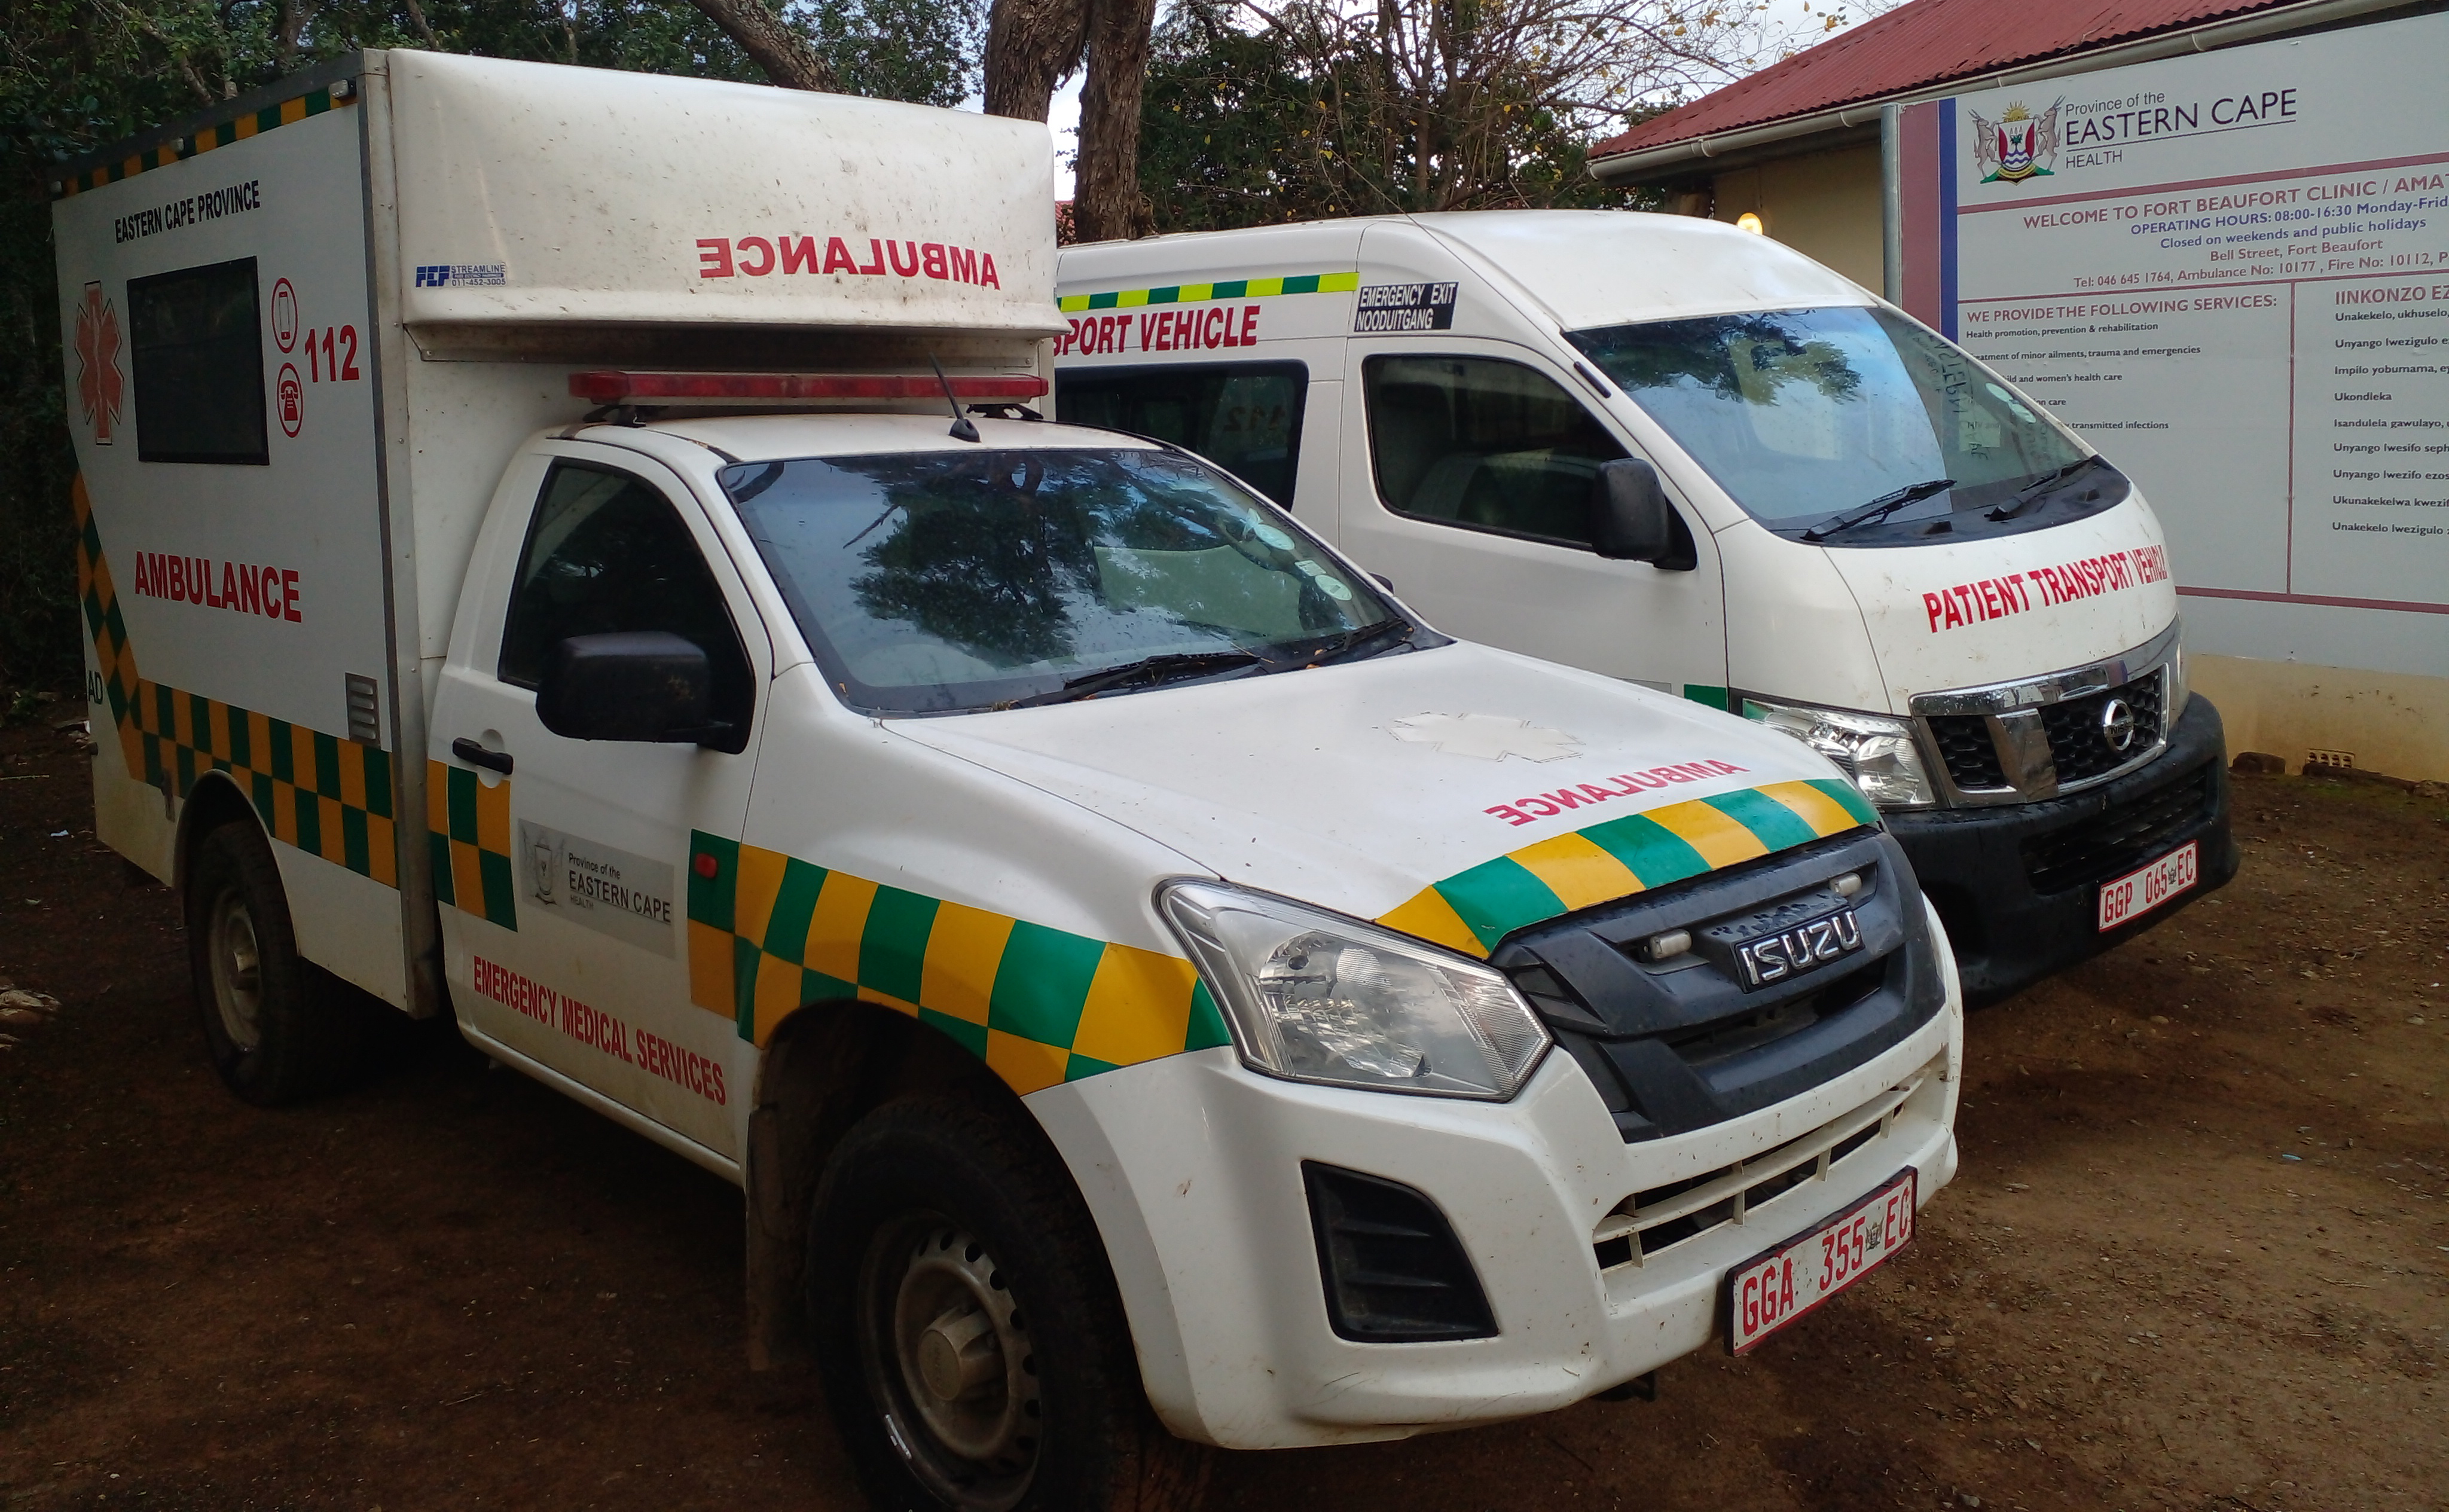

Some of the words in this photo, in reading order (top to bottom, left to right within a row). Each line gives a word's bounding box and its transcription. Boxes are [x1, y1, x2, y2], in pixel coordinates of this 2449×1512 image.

[2066, 98, 2122, 117] Province
[2127, 93, 2139, 108] of
[2144, 91, 2165, 105] the
[2066, 102, 2198, 145] EASTERN
[2212, 88, 2297, 124] CAPE
[2066, 149, 2123, 169] HEALTH
[115, 209, 163, 245] EASTERN
[165, 197, 195, 231] CAPE
[198, 179, 261, 224] PROVINCE
[2024, 208, 2108, 229] WELCOME
[2113, 206, 2138, 221] TO
[2143, 199, 2191, 218] FORT
[2197, 188, 2301, 212] BEAUFORT
[2307, 181, 2377, 201] CLINIC
[2383, 179, 2389, 194] /
[2130, 218, 2211, 235] OPERATING
[2216, 213, 2272, 227] HOURS:
[2274, 204, 2352, 222] 08:00-16:30
[2160, 235, 2201, 249] Closed
[2206, 236, 2221, 246] on
[2225, 228, 2289, 243] weekends
[2293, 225, 2317, 238] and
[2322, 222, 2364, 239] public
[2368, 217, 2426, 232] holidays
[2210, 250, 2234, 261] Bell
[2239, 247, 2283, 259] Street,
[2288, 244, 2317, 256] Fort
[2322, 239, 2383, 253] Beaufort
[451, 264, 506, 273] STREAMLINE
[2074, 277, 2094, 288] Tel:
[2097, 275, 2116, 286] 046
[2120, 274, 2140, 285] 645
[2145, 271, 2173, 283] 1764,
[2177, 267, 2247, 280] Ambulance
[2250, 264, 2273, 276] No:
[2279, 261, 2316, 273] 10177
[2328, 258, 2355, 270] Fire
[2359, 256, 2384, 268] No:
[2390, 252, 2433, 267] 10112,
[1359, 284, 1425, 308] EMERGENCY
[1433, 282, 1456, 305] EXIT
[2335, 286, 2426, 305] IINKONZO
[1355, 308, 1434, 331] NOODUITGANG
[1967, 311, 1990, 323] WE
[1994, 307, 2054, 322] PROVIDE
[2056, 305, 2086, 318] THE
[2090, 299, 2189, 317] FOLLOWING
[2193, 294, 2277, 311] SERVICES:
[2335, 311, 2395, 321] Unakekelo,
[1140, 306, 1262, 352] VEHICLE
[1966, 329, 1993, 338] Health
[1995, 328, 2041, 340] promotion,
[2042, 326, 2086, 337] prevention
[2098, 322, 2158, 332] rehabilitation
[304, 325, 360, 383] 112
[2011, 352, 2020, 360] of
[2022, 351, 2046, 359] minor
[2048, 350, 2087, 359] ailments,
[2123, 347, 2139, 356] and
[2142, 345, 2201, 357] emergencies
[2335, 339, 2382, 350] Unyango
[2386, 336, 2438, 348] lwezigulo
[2019, 375, 2034, 383] and
[2036, 374, 2072, 382] women's
[2074, 373, 2101, 381] health
[2335, 365, 2369, 377] Impilo
[2334, 392, 2392, 401] Ukondleka
[2072, 421, 2123, 429] transmitted
[2126, 421, 2169, 429] infections
[2334, 419, 2387, 427] Isandulela
[2390, 419, 2444, 429] gawulayo,
[2334, 443, 2380, 454] Unyango
[2384, 443, 2421, 453] lwesifo
[2333, 469, 2380, 481] Unyango
[2383, 470, 2421, 479] lwezifo
[2333, 496, 2410, 506] Ukunakekelwa
[2332, 522, 2388, 532] Unakekelo
[2392, 524, 2443, 536] lwezigulo
[135, 550, 302, 624] AMBULANCE
[1922, 572, 2031, 634] PATIENT
[2028, 551, 2135, 609] TRANSPORT
[569, 851, 598, 874] Province
[600, 863, 608, 876] of
[609, 866, 621, 879] the
[569, 870, 630, 909] EASTERN
[633, 895, 672, 923] CAPE
[2104, 881, 2133, 924] GGP
[2145, 866, 2168, 904] 065
[2178, 849, 2194, 885] EC
[569, 894, 594, 911] HEALTH
[1739, 909, 1861, 986] ISUZU
[474, 955, 558, 1029] EMERGENCY
[562, 995, 633, 1064] MEDICAL
[636, 1028, 726, 1106] SERVICES
[1742, 1256, 1794, 1337] GGA
[1819, 1215, 1866, 1291] 355
[1884, 1185, 1911, 1251] EC
